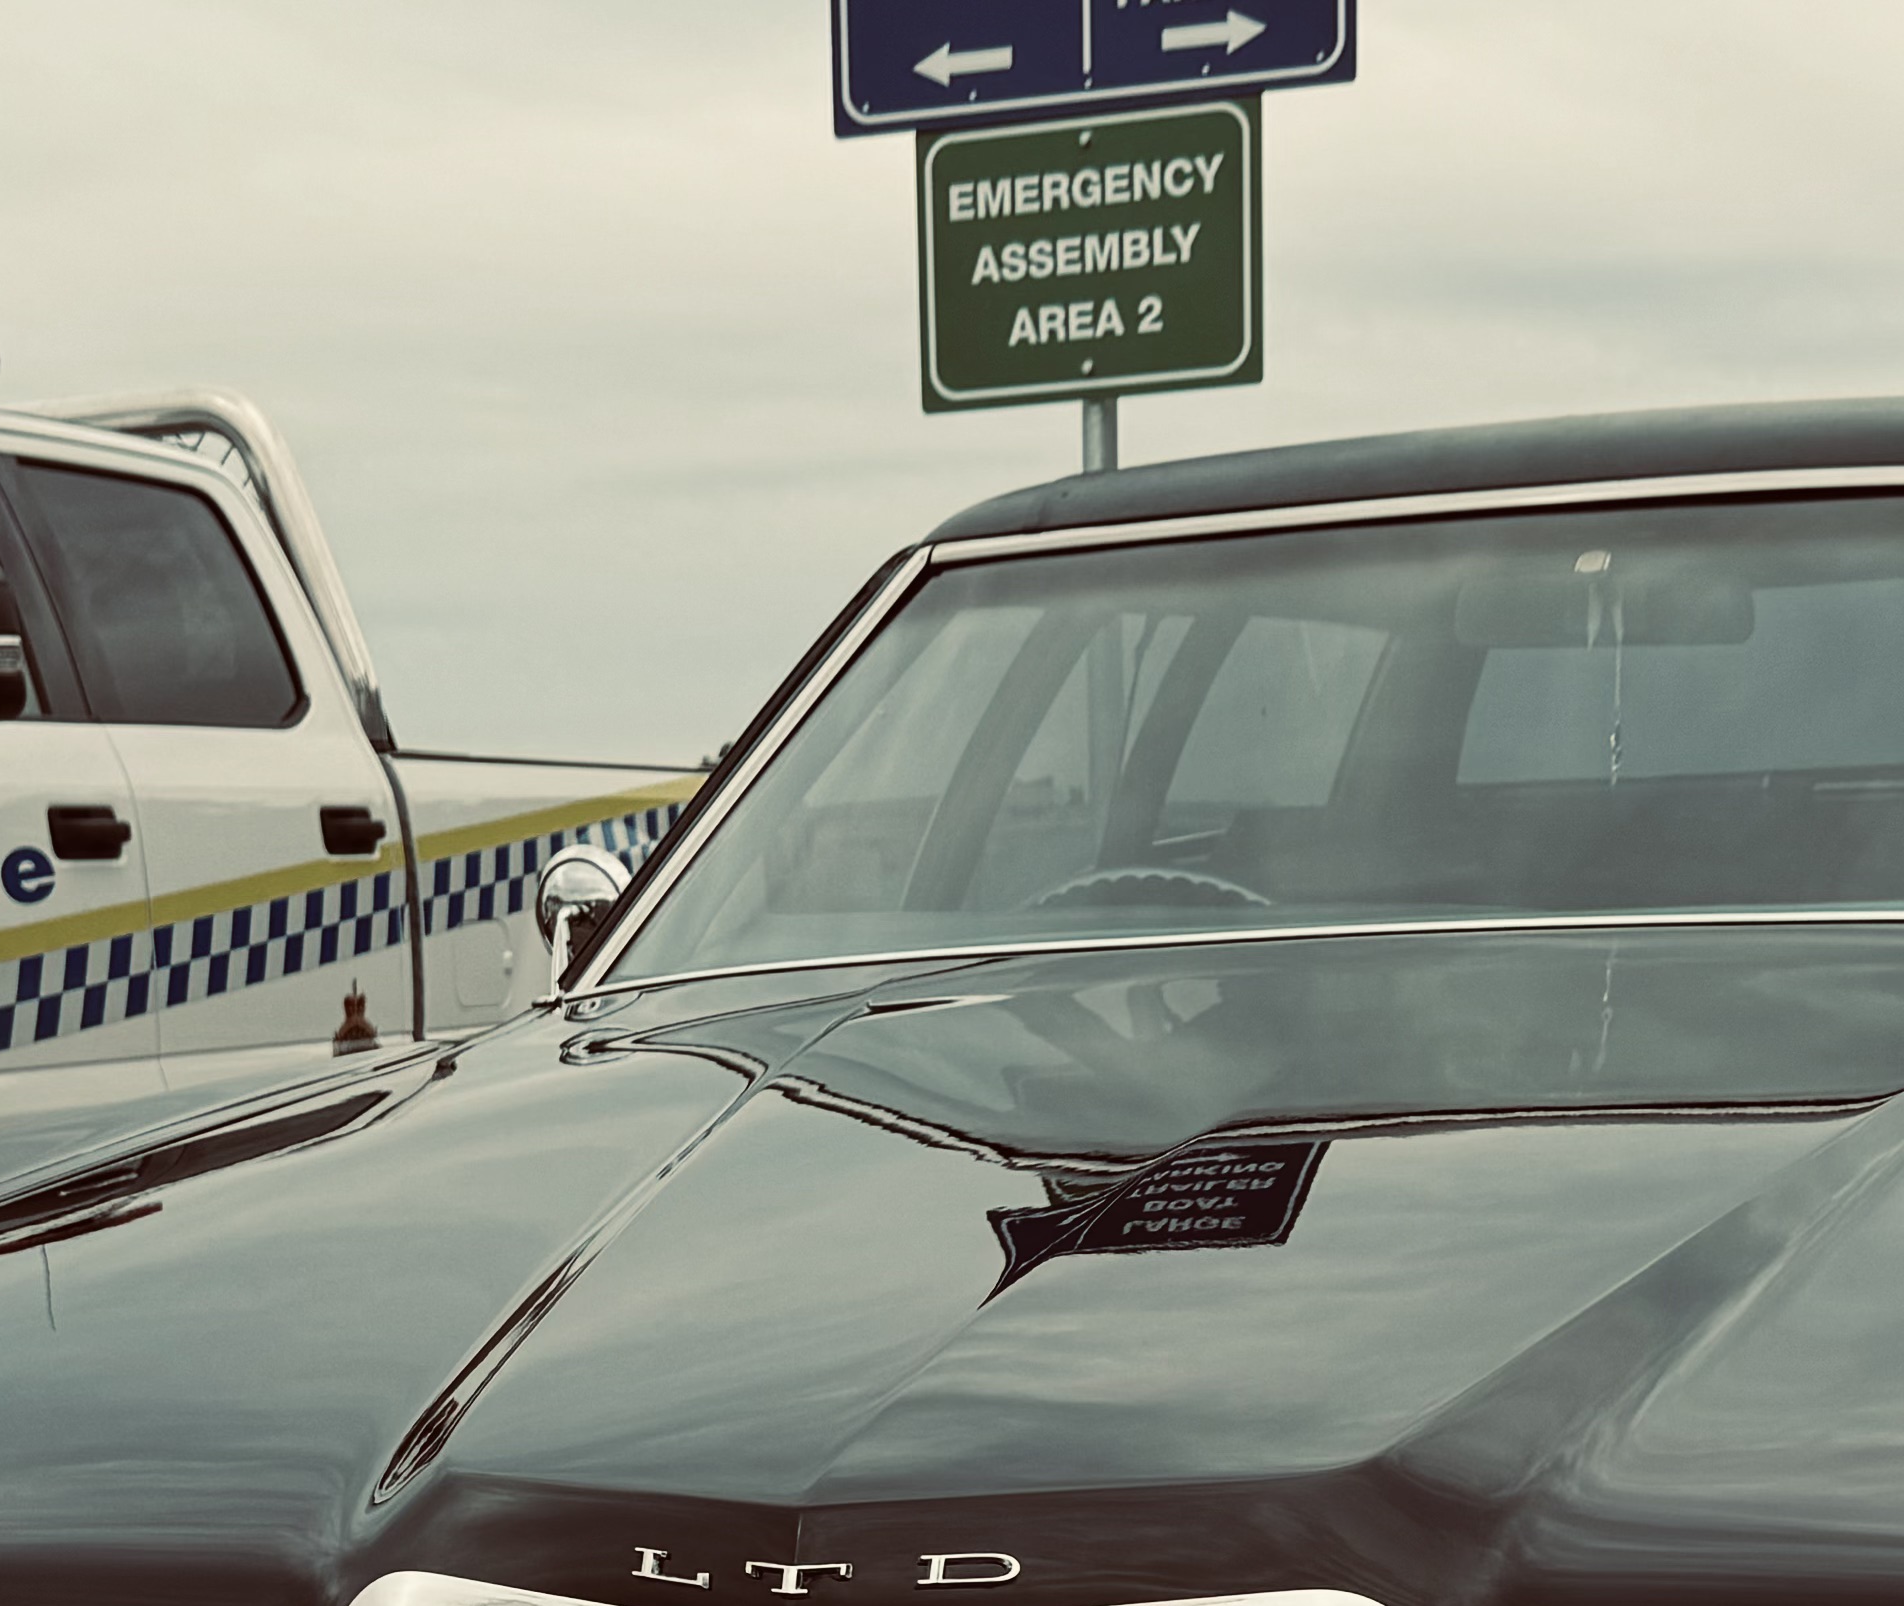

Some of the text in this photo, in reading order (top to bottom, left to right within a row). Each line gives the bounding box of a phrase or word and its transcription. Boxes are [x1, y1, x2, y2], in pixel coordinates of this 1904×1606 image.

[948, 153, 1224, 222] EMERGENCY
[971, 223, 1201, 285] ASSEMBLY
[1008, 295, 1163, 347] AREA 2
